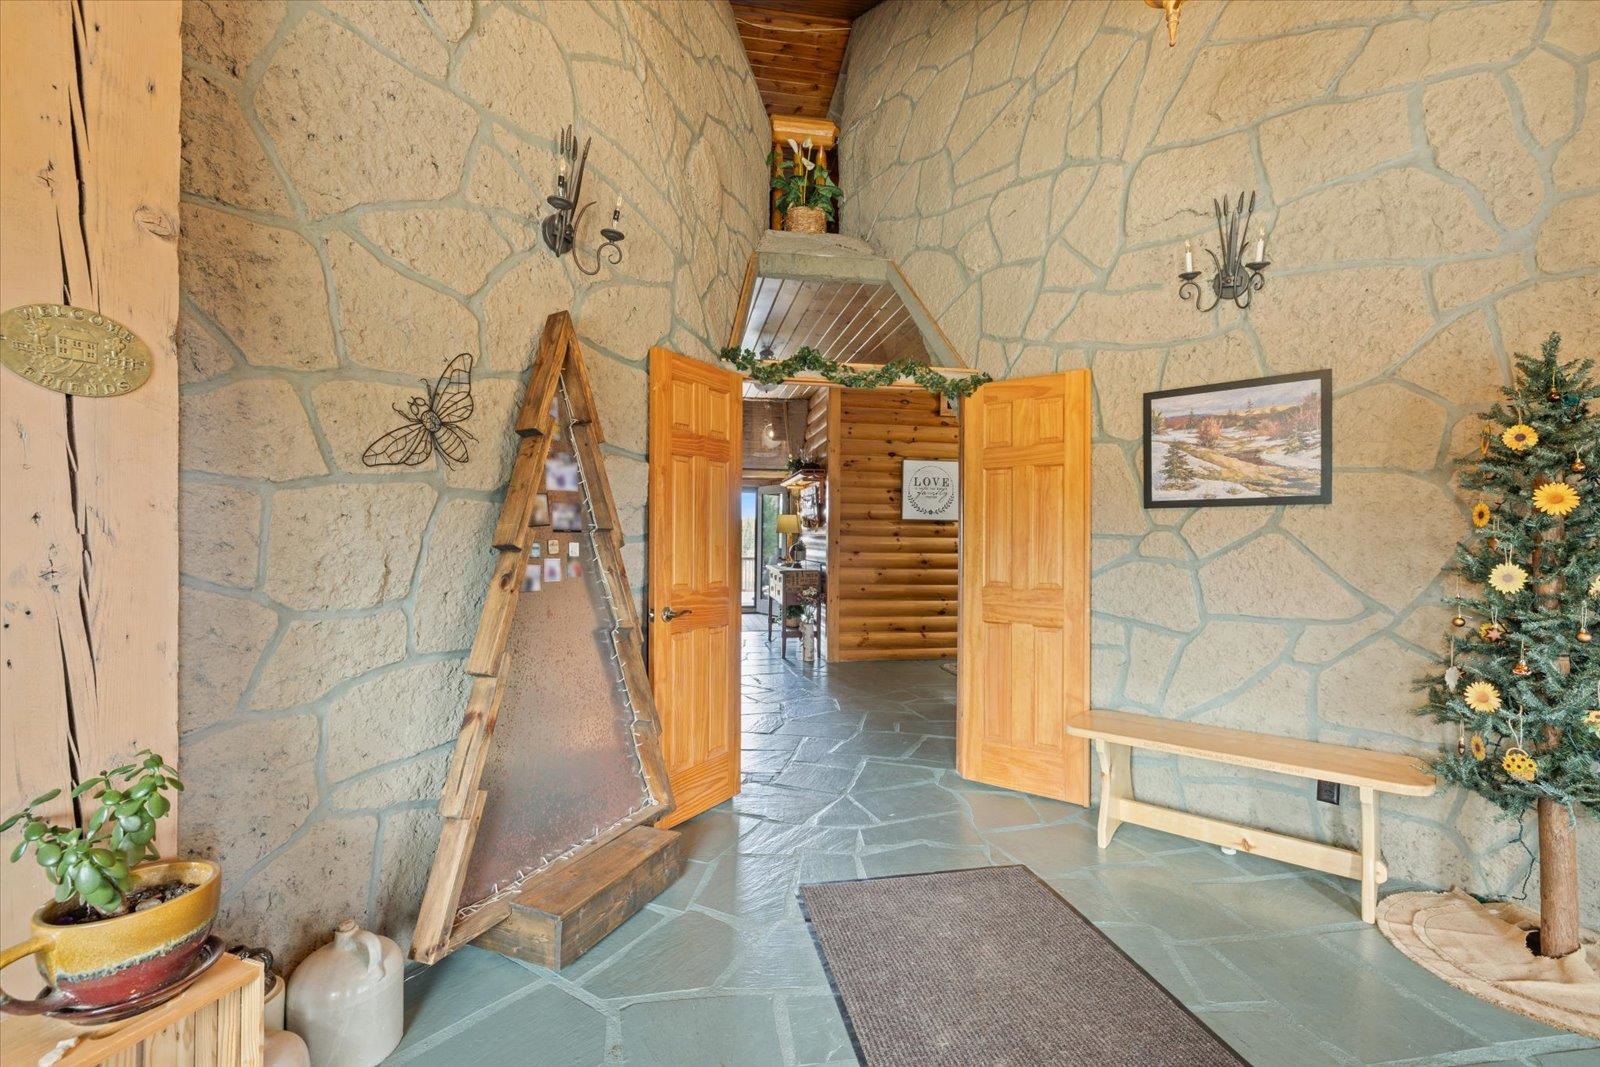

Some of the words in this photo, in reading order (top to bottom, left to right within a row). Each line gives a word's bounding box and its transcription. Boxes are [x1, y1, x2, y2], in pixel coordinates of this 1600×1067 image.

[16, 305, 136, 344] WELCOME
[21, 366, 133, 396] FRIENDS
[914, 476, 950, 487] LOVE
